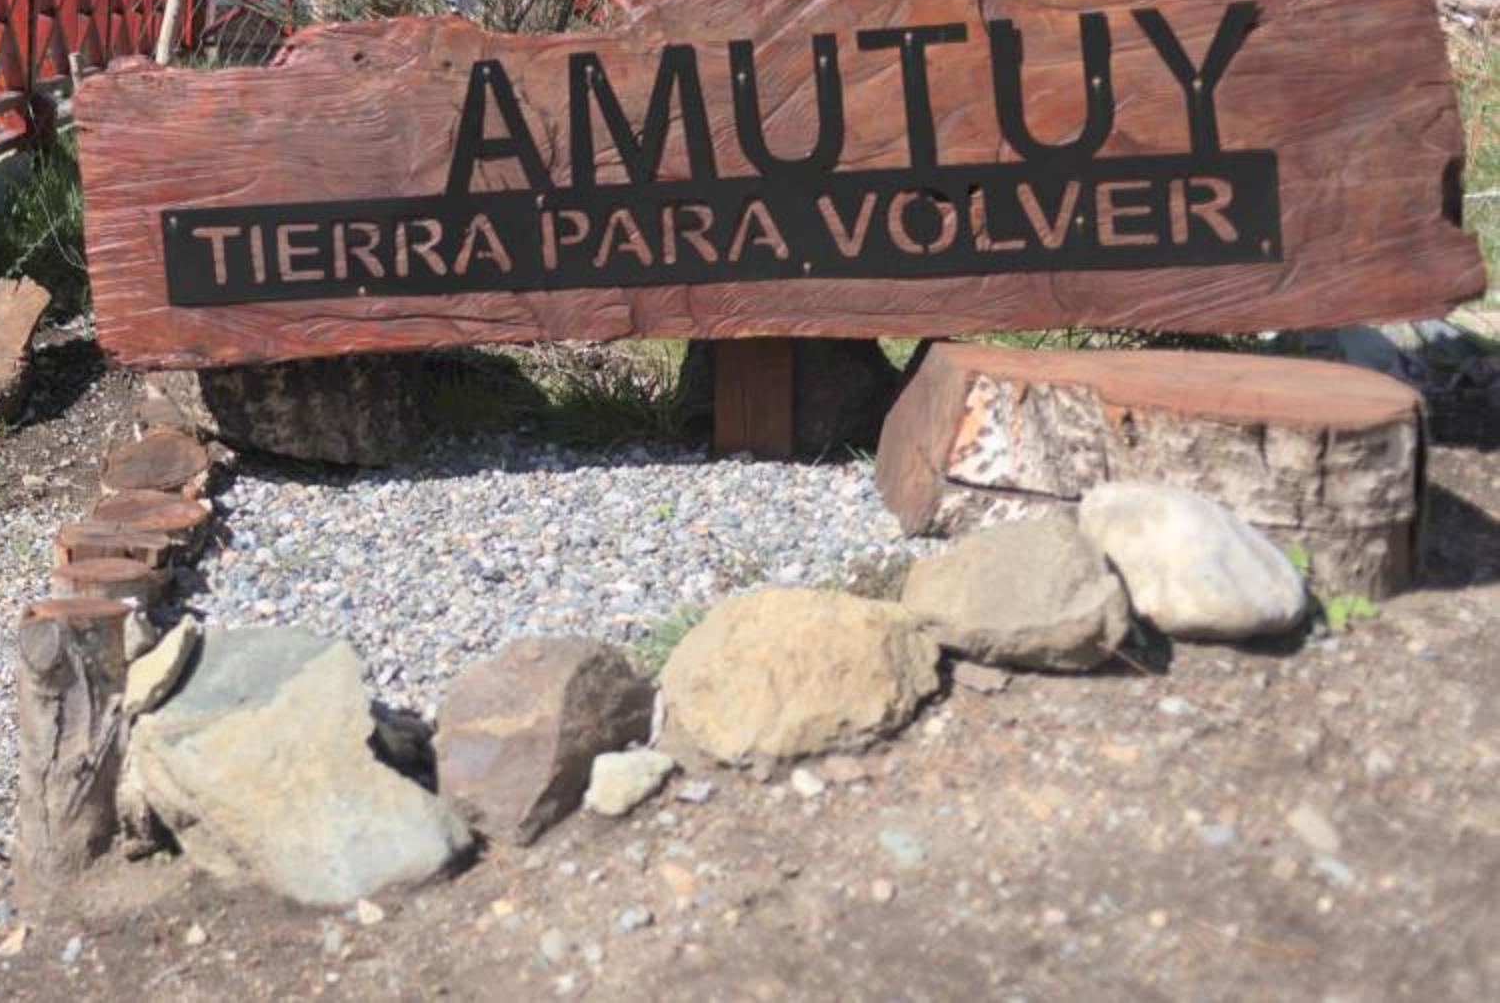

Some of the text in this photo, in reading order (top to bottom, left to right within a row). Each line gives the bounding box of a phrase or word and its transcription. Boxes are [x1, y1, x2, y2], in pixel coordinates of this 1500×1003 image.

[448, 1, 1258, 195] AMUTUY
[192, 176, 1238, 285] TIERRA PARA VOLVER
